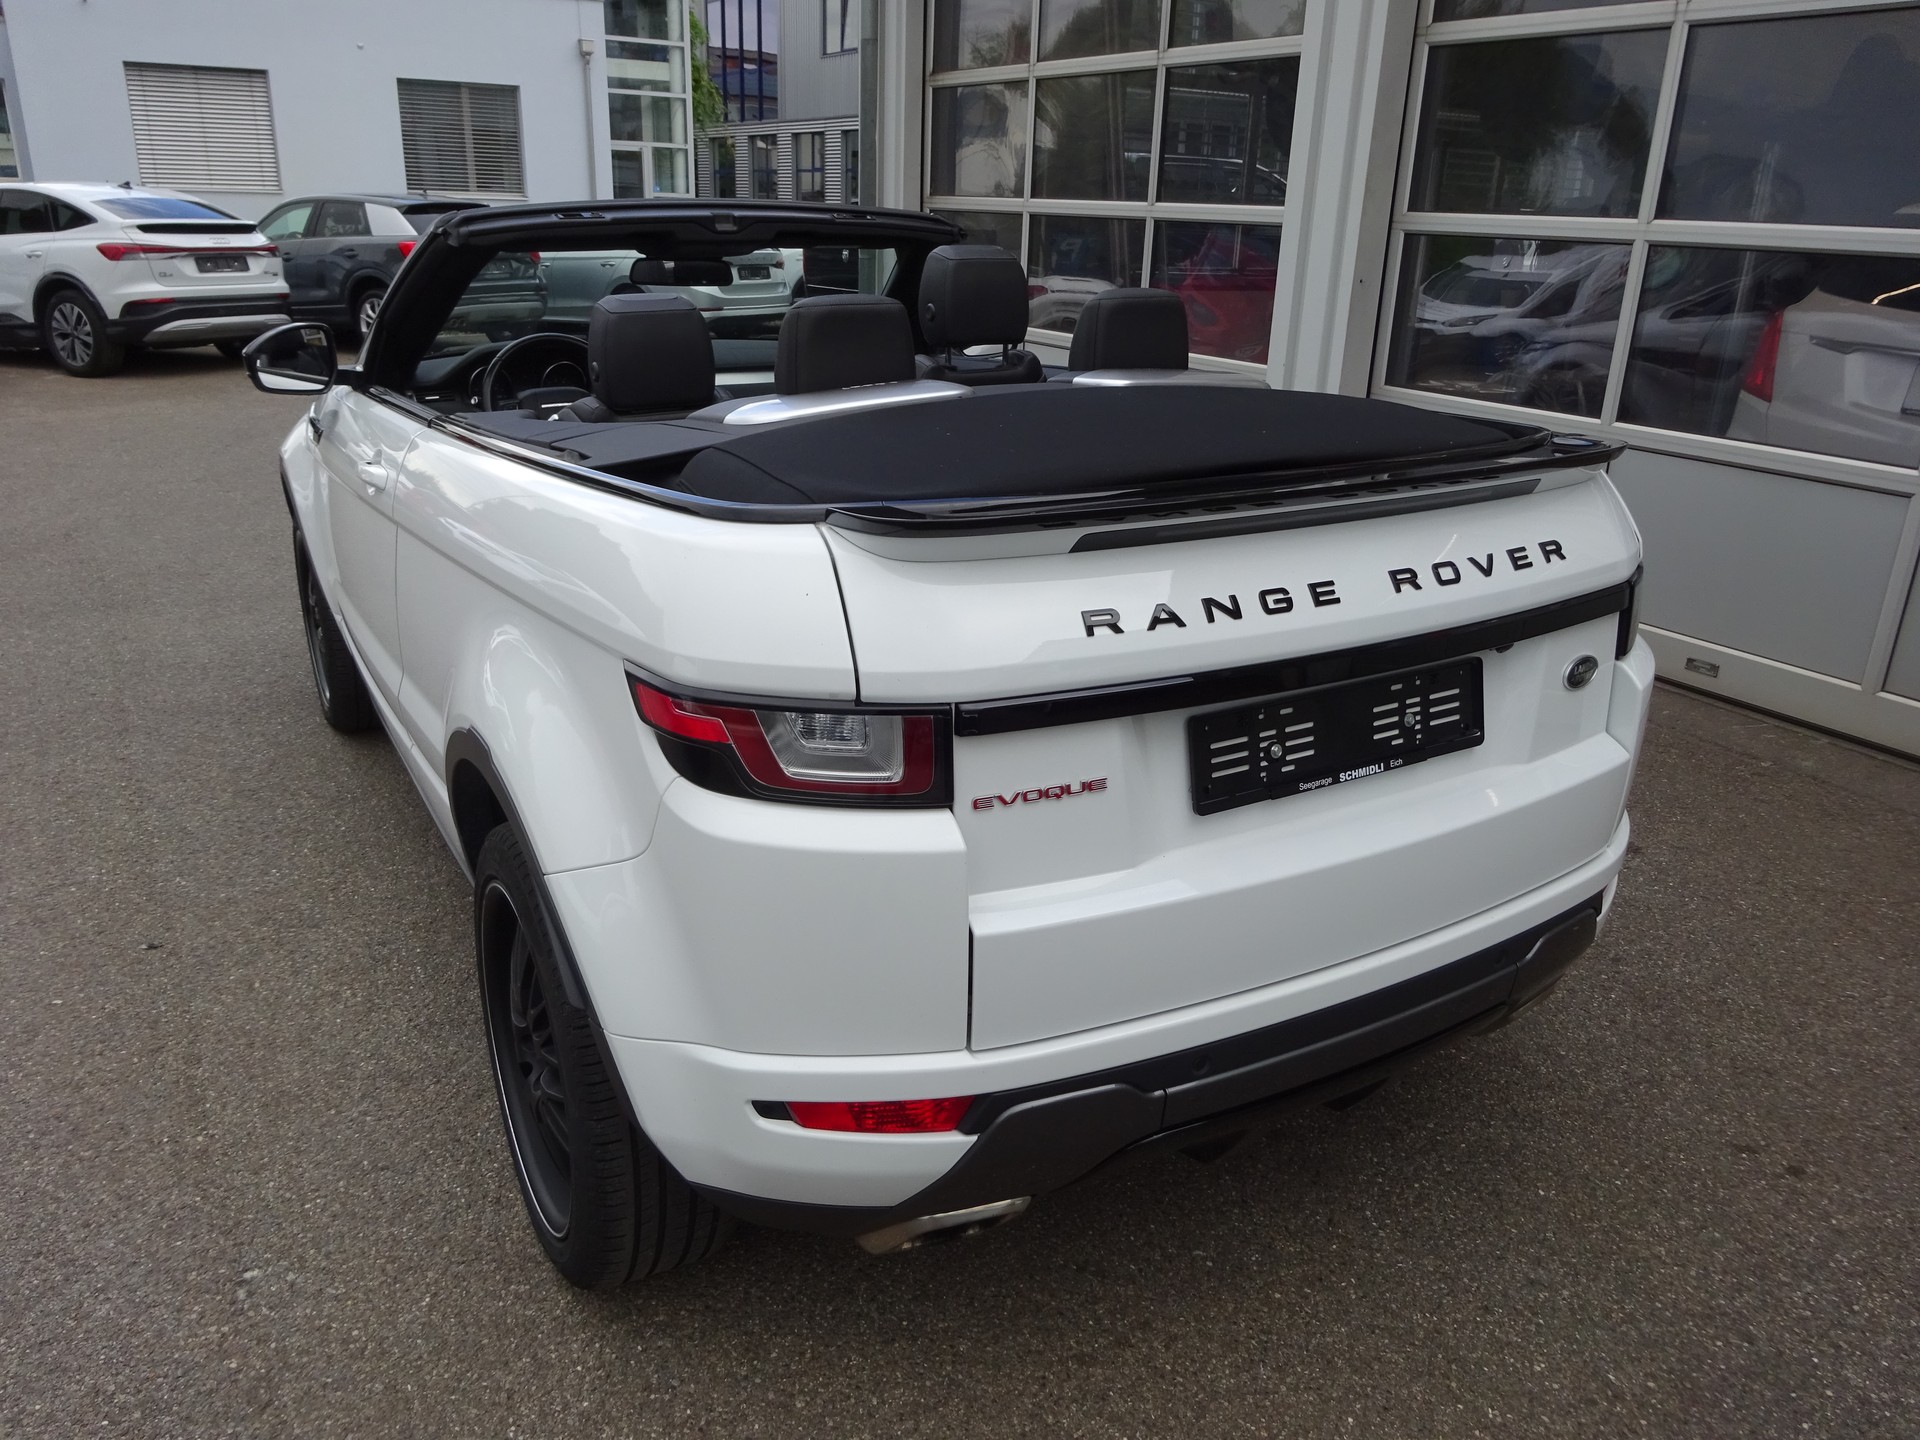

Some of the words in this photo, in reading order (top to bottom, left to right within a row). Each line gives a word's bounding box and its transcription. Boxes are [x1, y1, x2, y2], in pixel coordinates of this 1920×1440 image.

[1081, 579, 1342, 638] RANGE
[1387, 539, 1567, 594] ROVER
[1299, 777, 1333, 790] Seegarage
[1339, 762, 1385, 782] SCHMIDLI
[1389, 758, 1403, 768] Eich
[971, 776, 1108, 811] EVOQUE
